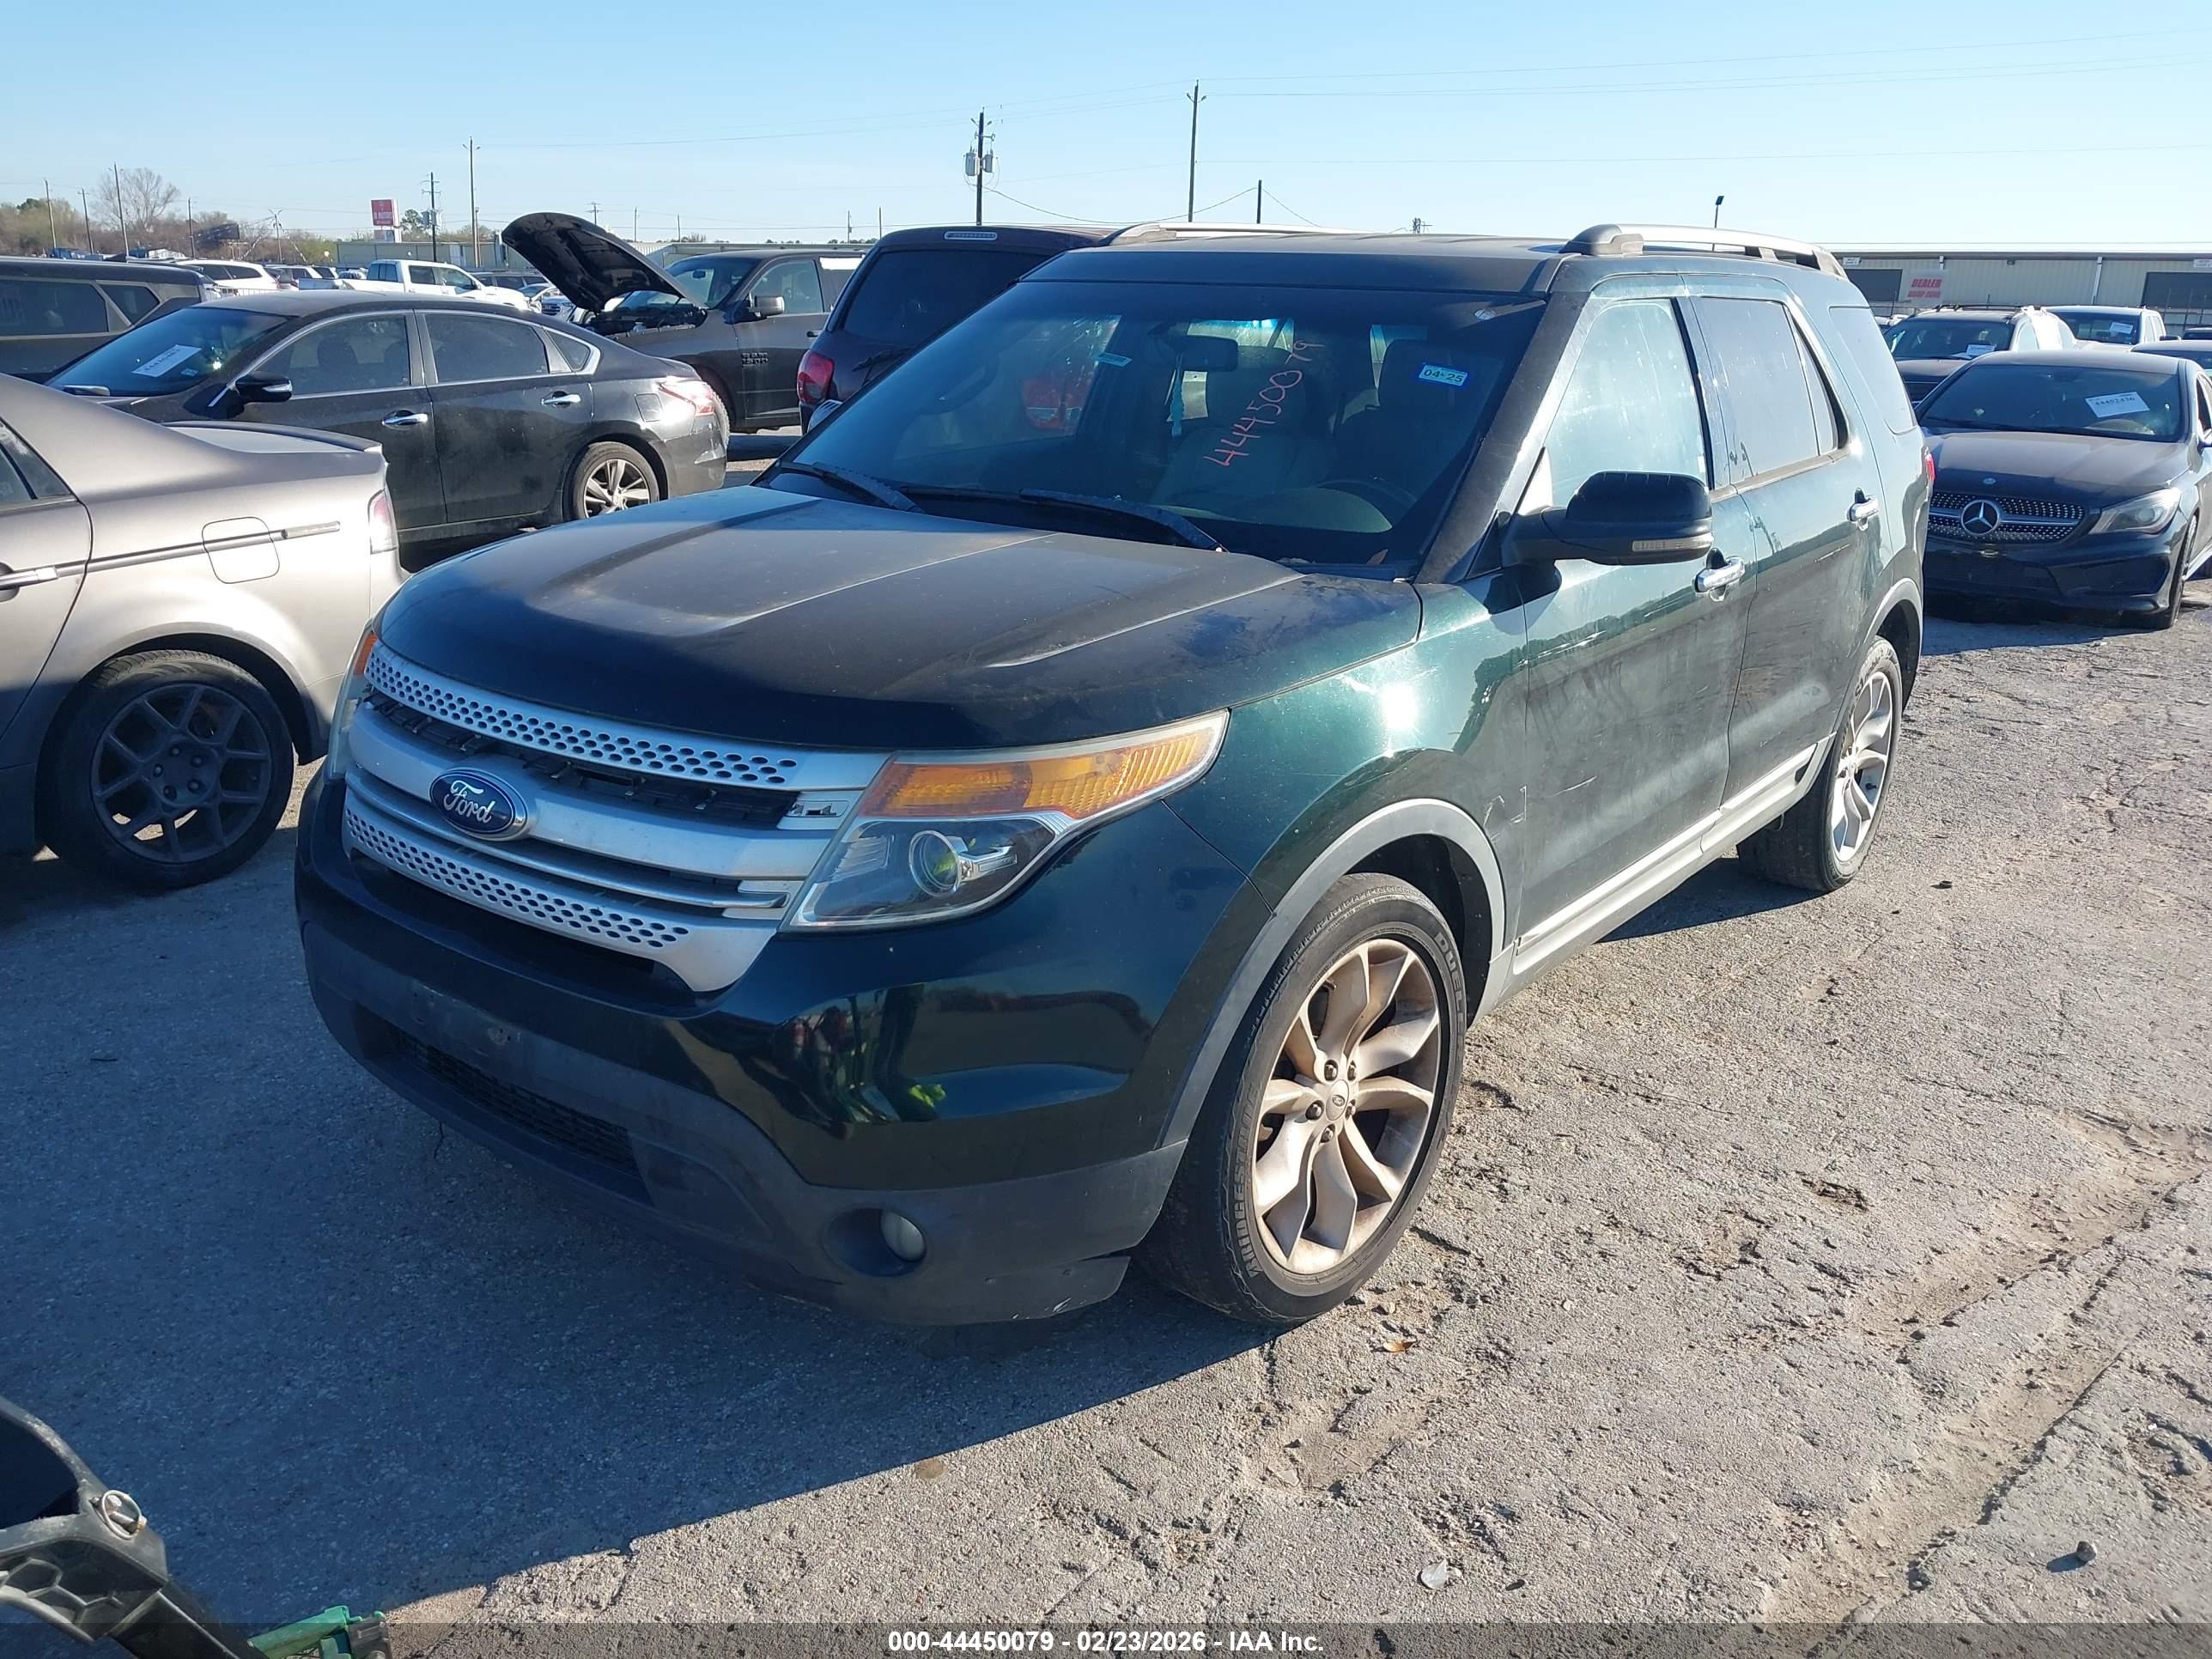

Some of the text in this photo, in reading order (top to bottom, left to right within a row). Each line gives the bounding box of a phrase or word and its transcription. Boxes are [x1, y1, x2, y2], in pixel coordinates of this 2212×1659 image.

[1911, 278, 1942, 288] DEALER
[1424, 369, 1462, 382] 04 25
[1203, 340, 1325, 466] 44450079
[443, 780, 495, 823] Ford
